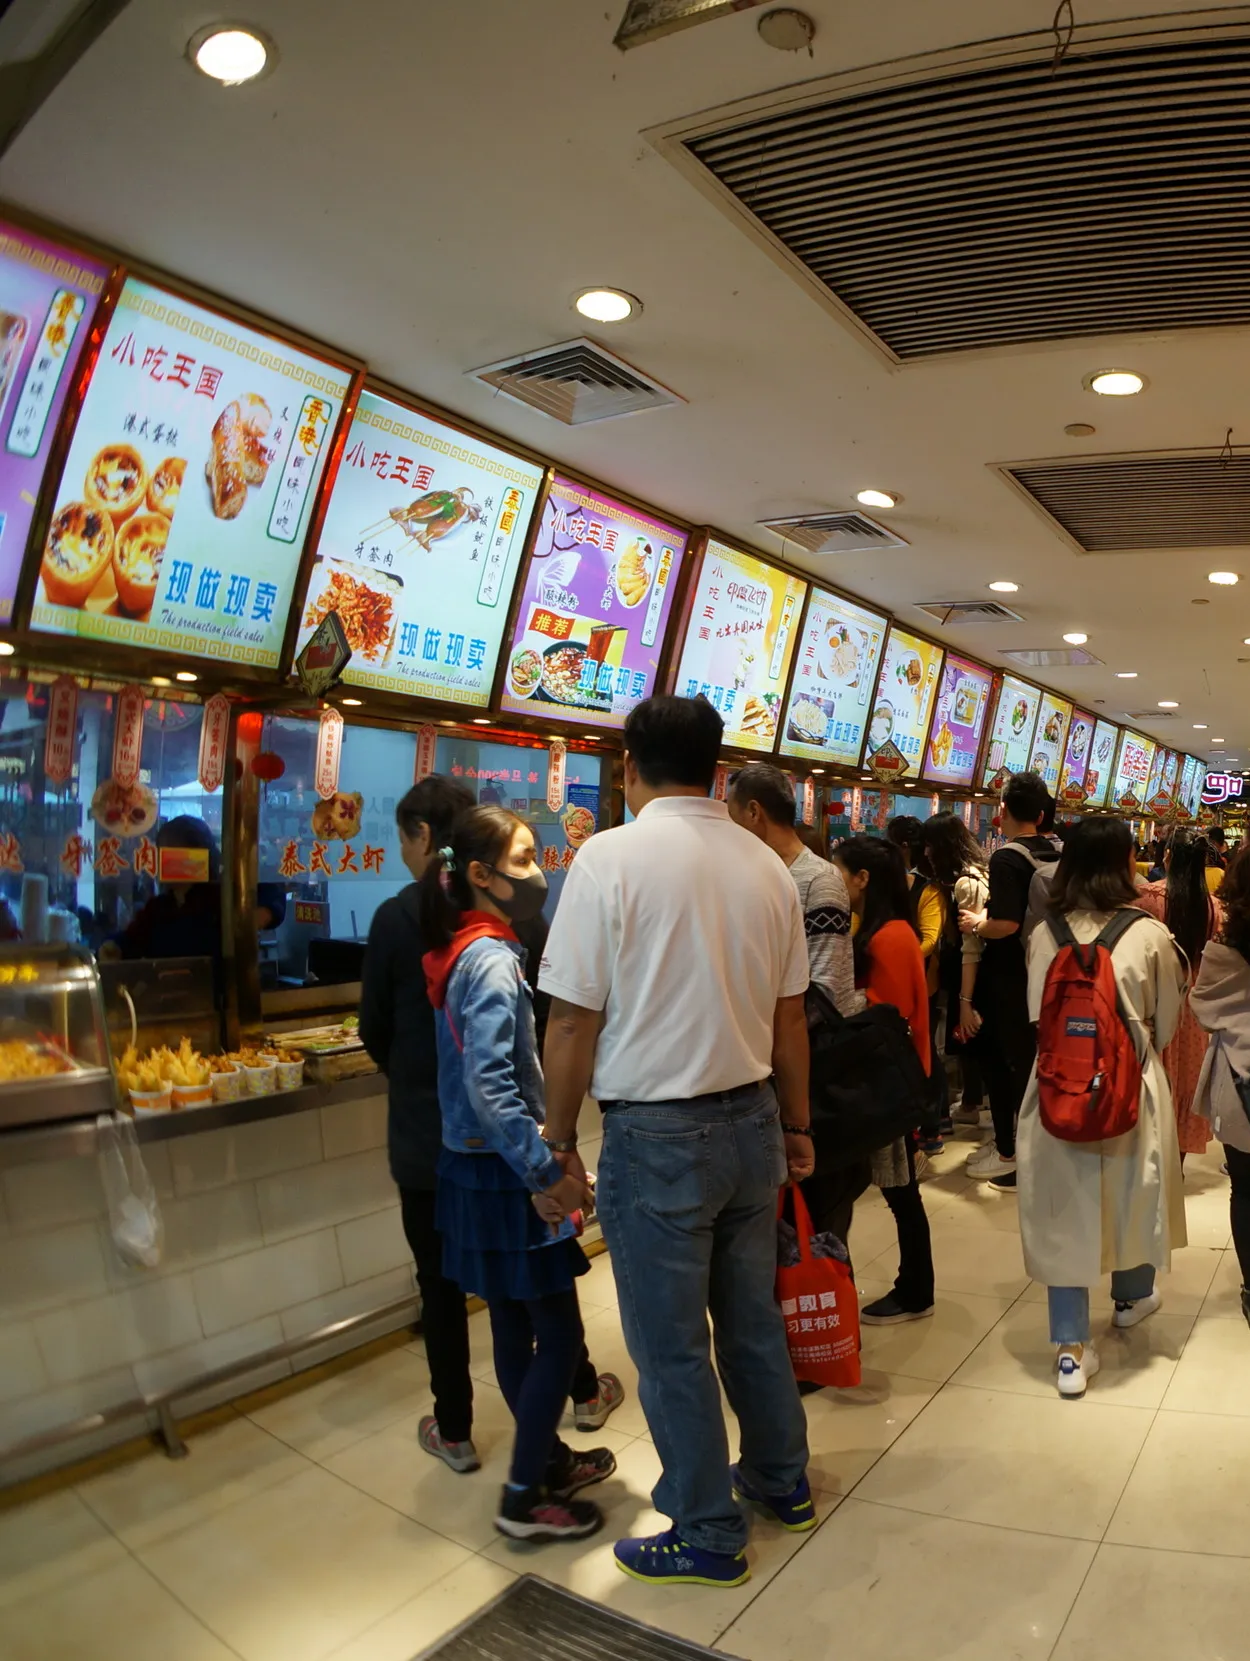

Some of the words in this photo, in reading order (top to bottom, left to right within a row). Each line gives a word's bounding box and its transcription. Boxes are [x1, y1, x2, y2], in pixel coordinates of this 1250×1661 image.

[111, 331, 224, 400] 小吃王国
[298, 398, 329, 456] 香港
[346, 441, 435, 491] 小吃王国
[550, 507, 620, 553] 小吃王国
[353, 541, 395, 568] 牙签肉
[165, 558, 278, 623] 现做现卖
[698, 566, 724, 641] 小吃王国
[161, 608, 176, 625] The
[176, 616, 221, 634] production
[221, 624, 243, 641] field
[244, 630, 265, 644] sales
[398, 621, 487, 671] 现做现卖
[534, 613, 570, 636] 推荐
[577, 658, 648, 700] 现做现卖
[278, 841, 386, 877] 泰式大虾
[787, 1313, 841, 1334] 习更有效
